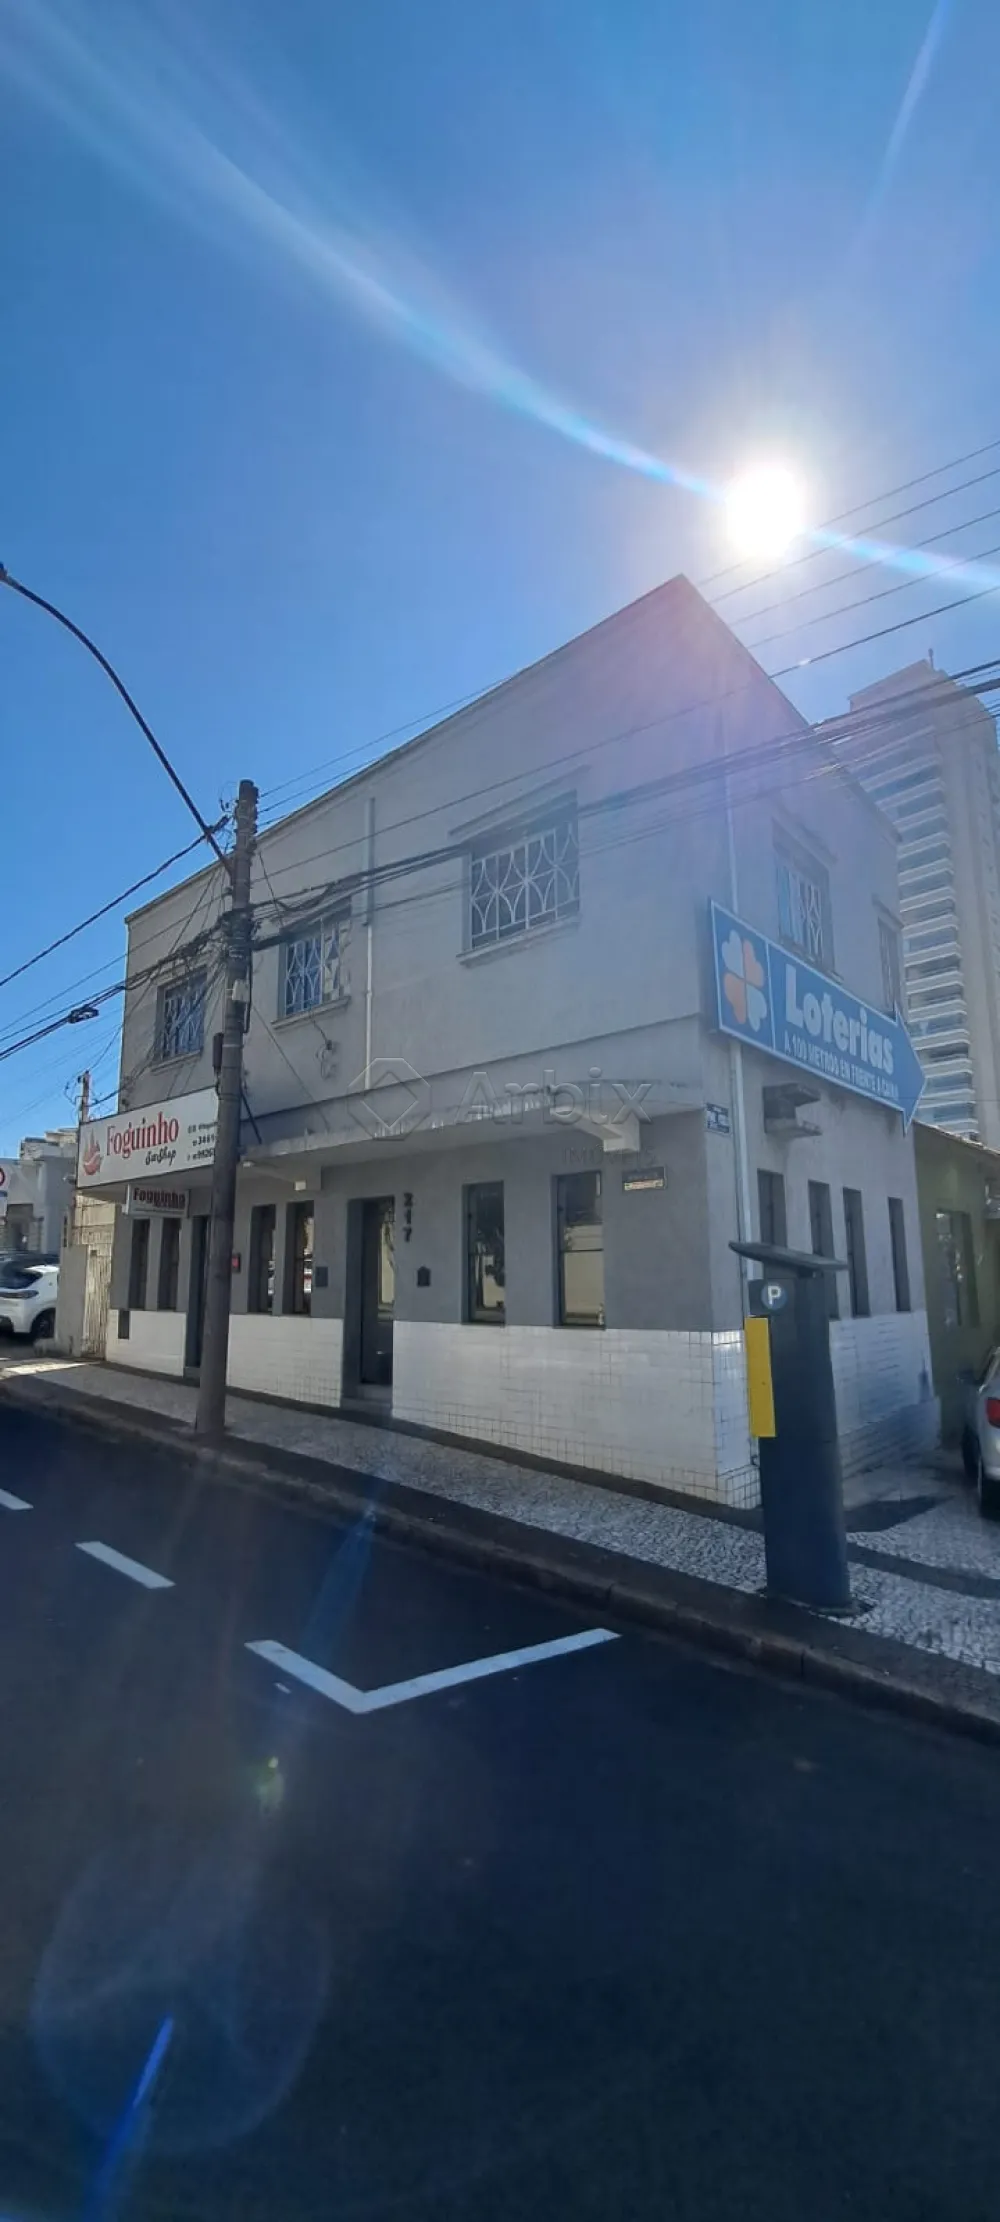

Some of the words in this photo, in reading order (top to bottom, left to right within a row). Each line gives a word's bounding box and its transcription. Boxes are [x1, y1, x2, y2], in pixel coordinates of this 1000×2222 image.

[785, 963, 894, 1075] Loterias
[792, 1033, 807, 1061] 100
[808, 1043, 839, 1076] METROS
[106, 1111, 179, 1158] Foguinho
[403, 1192, 413, 1243] 217
[768, 1285, 781, 1305] P
